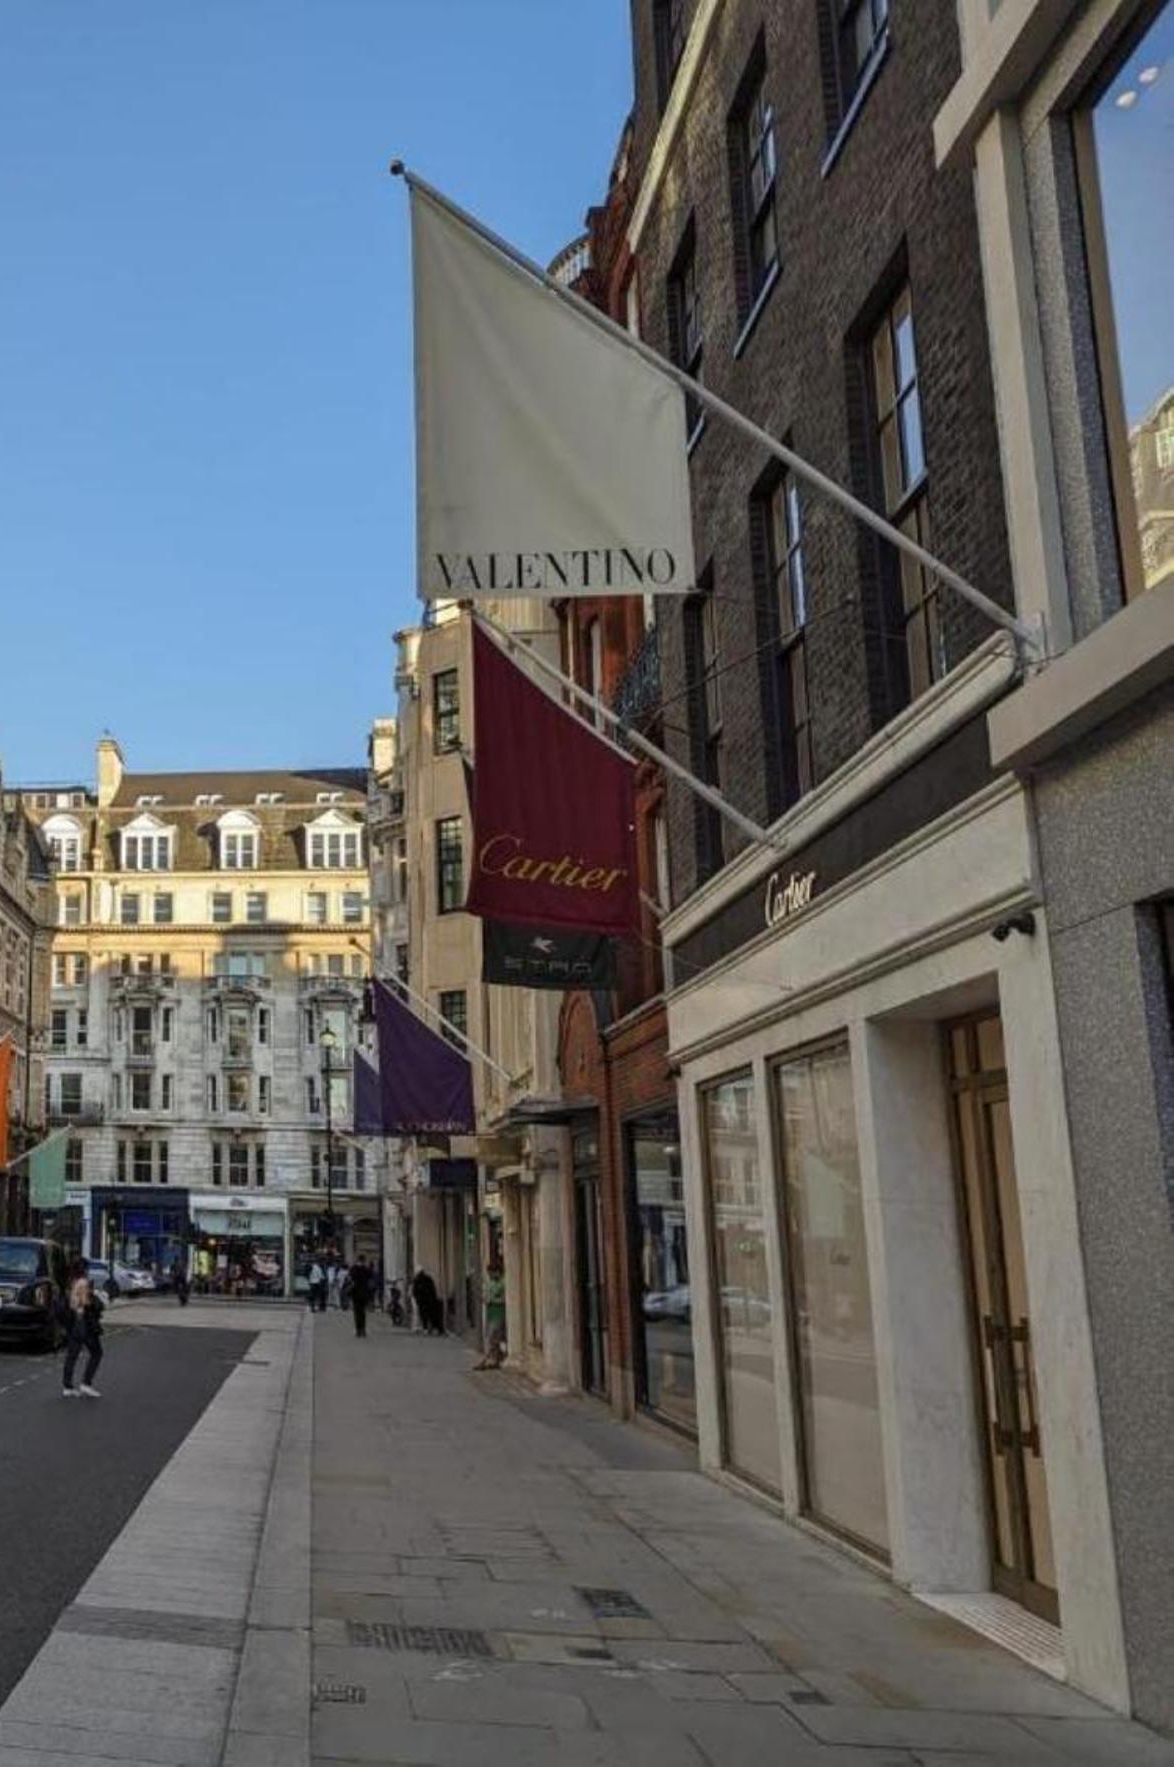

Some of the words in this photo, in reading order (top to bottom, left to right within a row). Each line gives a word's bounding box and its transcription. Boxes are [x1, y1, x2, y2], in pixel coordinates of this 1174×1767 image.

[433, 548, 676, 590] VALENTINO
[480, 834, 628, 892] Cartier
[764, 871, 816, 928] Cartier
